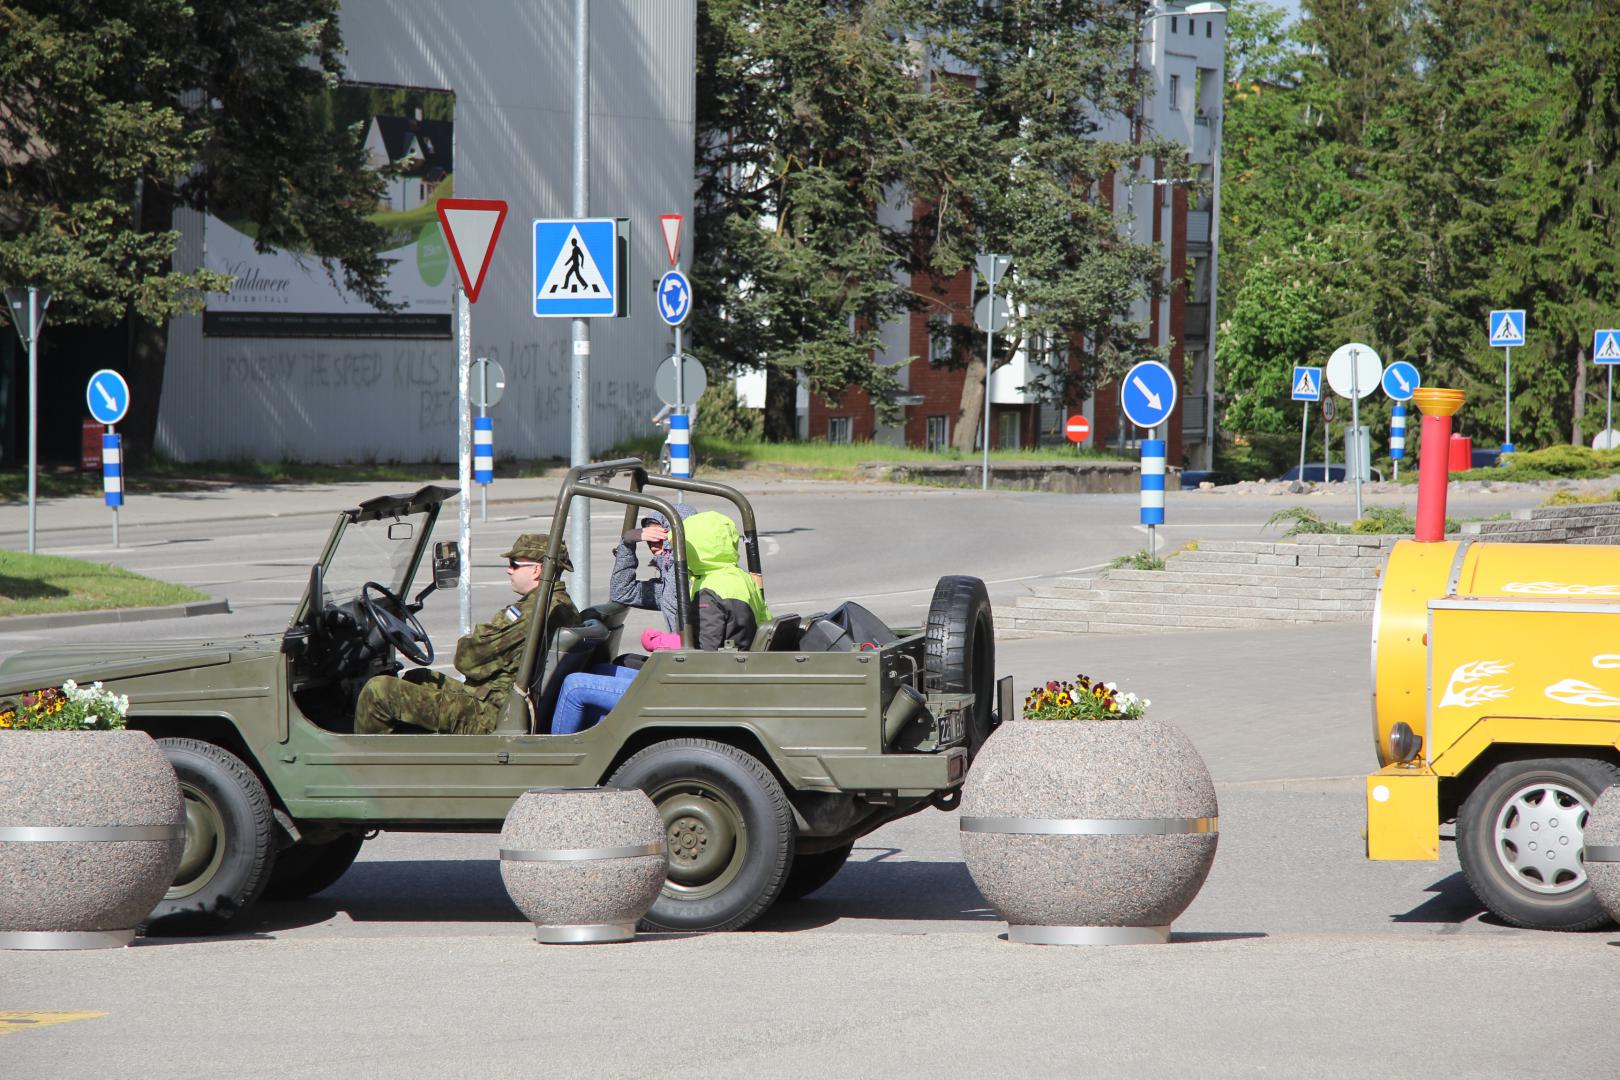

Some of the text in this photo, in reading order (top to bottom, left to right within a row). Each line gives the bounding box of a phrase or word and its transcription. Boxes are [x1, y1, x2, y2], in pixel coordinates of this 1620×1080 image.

[334, 351, 383, 390] SPEED
[393, 346, 440, 391] KILLS
[1325, 401, 1333, 415] 30
